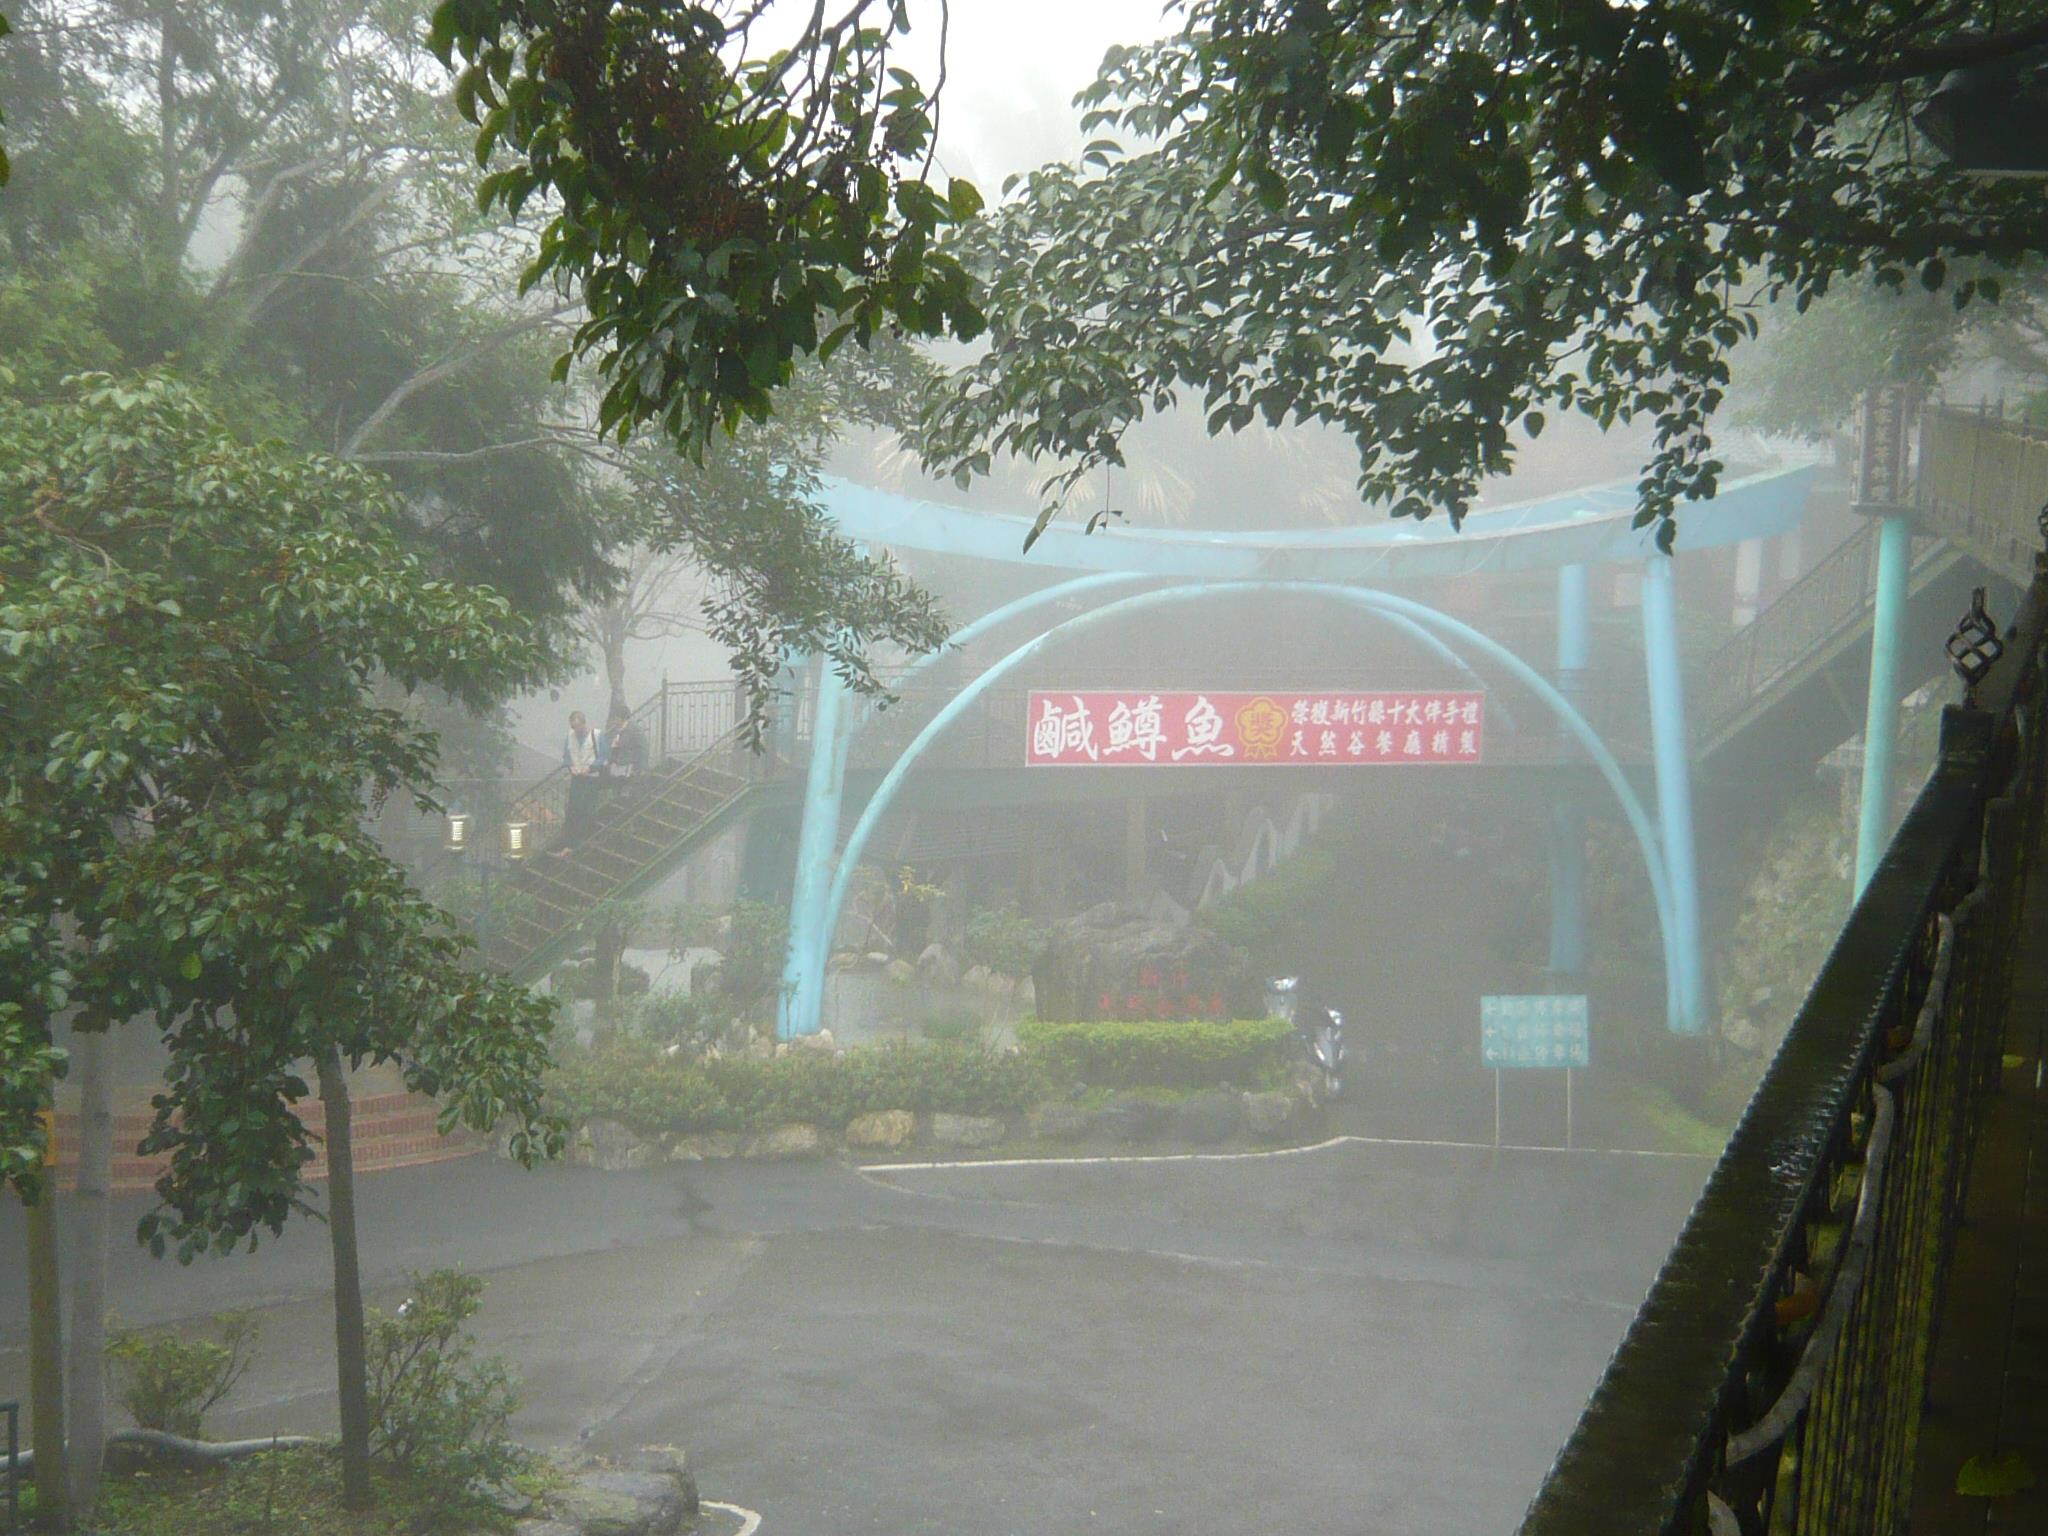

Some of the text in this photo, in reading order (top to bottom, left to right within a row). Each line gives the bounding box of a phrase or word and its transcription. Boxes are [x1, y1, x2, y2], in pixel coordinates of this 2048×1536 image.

[1291, 699, 1478, 726] 榮獲新竹縣十大伴手禮
[1033, 696, 1234, 761] 鹹鱒魚
[1290, 730, 1476, 756] 天然谷餐廳精製
